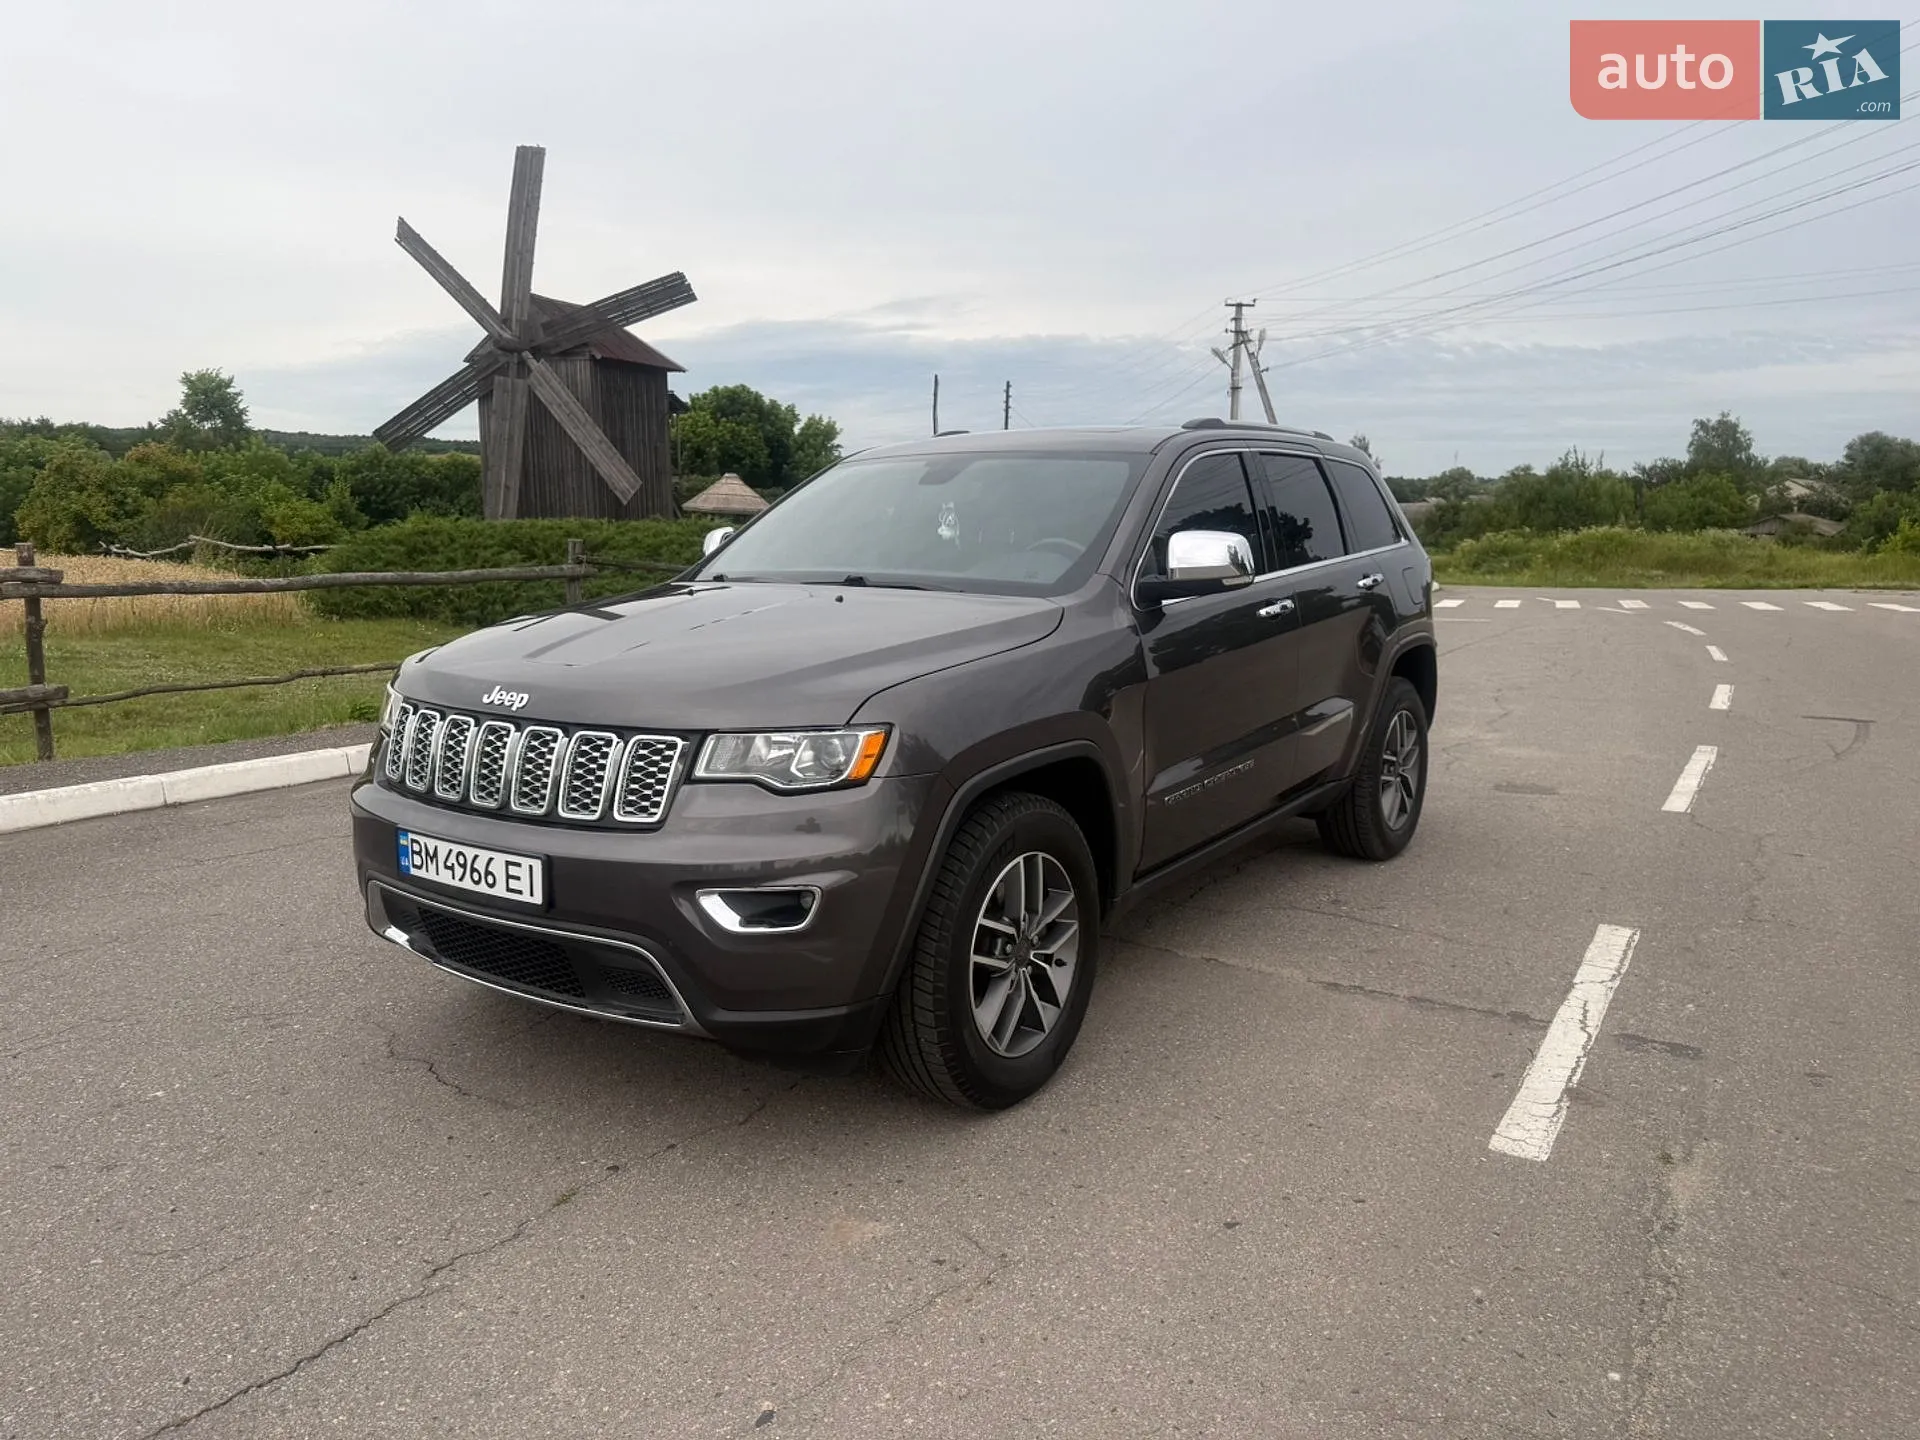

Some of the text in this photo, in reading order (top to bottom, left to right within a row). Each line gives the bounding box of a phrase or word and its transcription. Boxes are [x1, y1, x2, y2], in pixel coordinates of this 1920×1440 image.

[482, 685, 529, 712] Jeep
[410, 838, 534, 897] BM 4966 EI
